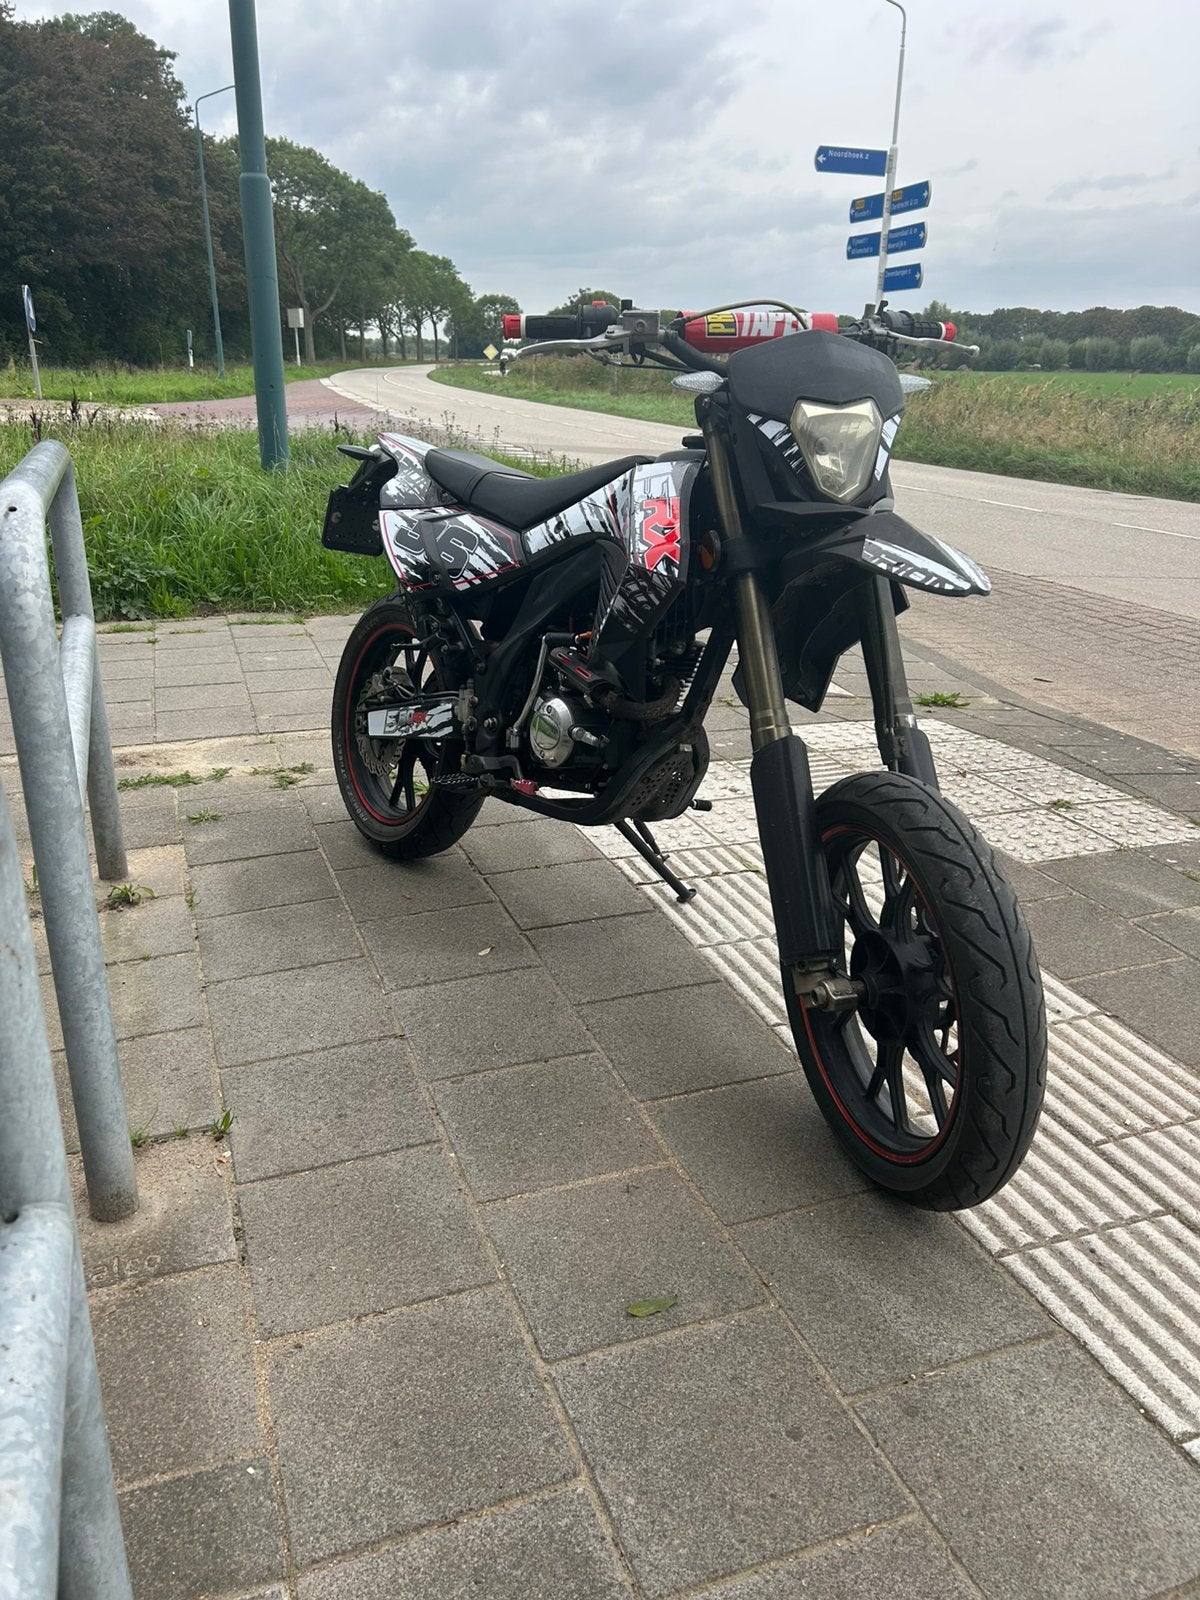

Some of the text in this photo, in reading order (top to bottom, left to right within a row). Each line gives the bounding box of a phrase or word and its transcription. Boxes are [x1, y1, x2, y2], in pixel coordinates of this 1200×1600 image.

[828, 150, 864, 160] Noordhoek
[643, 496, 681, 571] RX
[90, 1255, 161, 1281] alco
